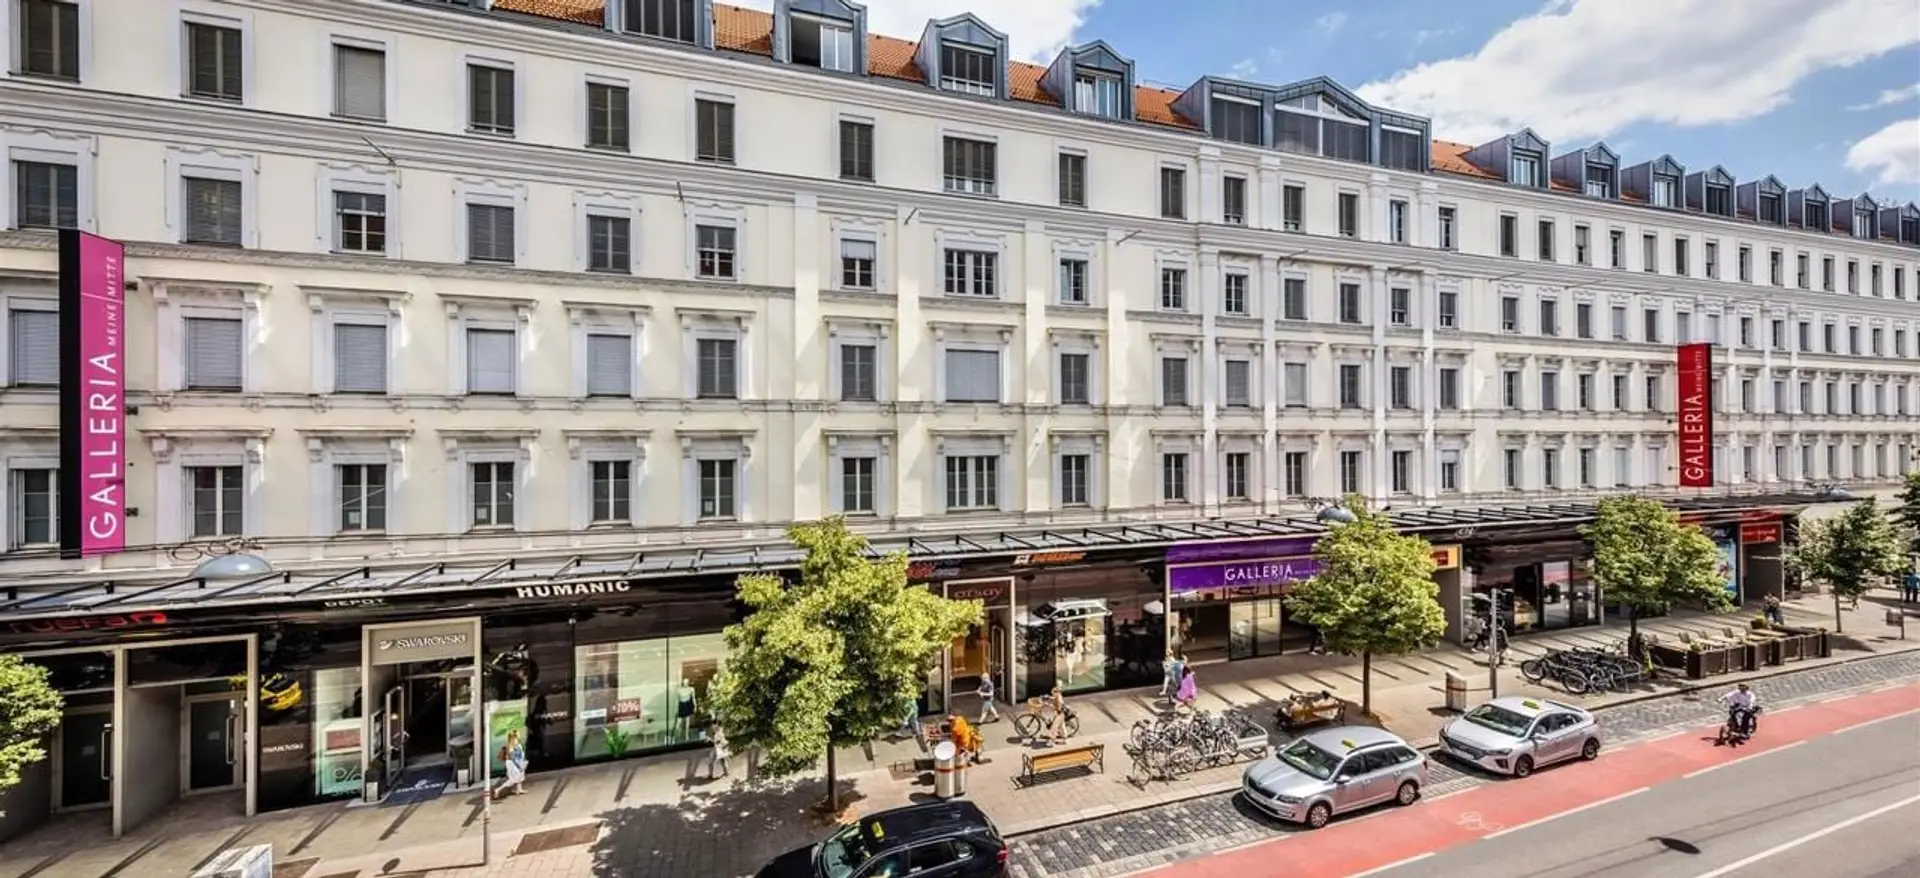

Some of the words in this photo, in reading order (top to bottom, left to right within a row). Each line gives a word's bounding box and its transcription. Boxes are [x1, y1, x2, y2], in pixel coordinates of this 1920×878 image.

[106, 256, 117, 297] MITTE
[106, 304, 117, 346] MEINE
[89, 352, 118, 539] GALLERIA
[1684, 394, 1705, 480] GALLERIA
[1225, 564, 1294, 581] GALLERIA
[324, 598, 384, 608] DEPOT
[516, 580, 630, 598] HUMANIC
[396, 633, 467, 649] SWAROVSKI
